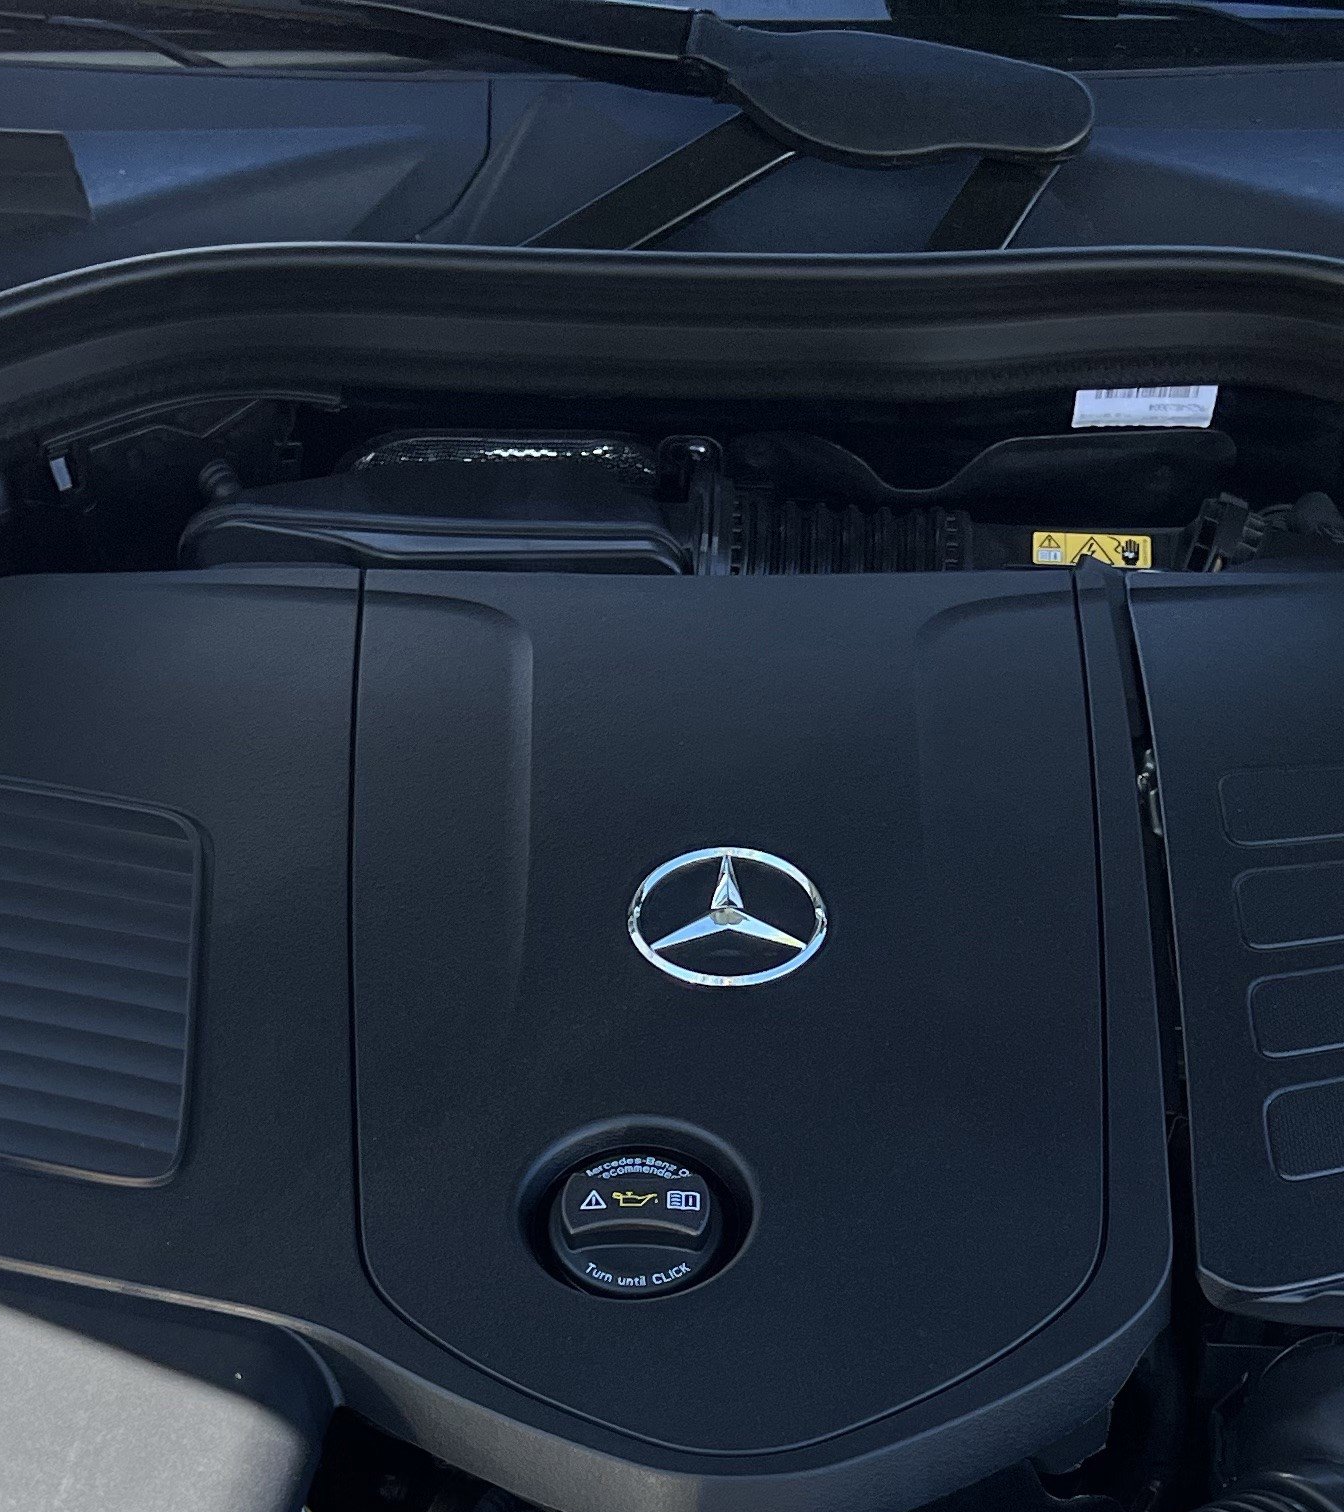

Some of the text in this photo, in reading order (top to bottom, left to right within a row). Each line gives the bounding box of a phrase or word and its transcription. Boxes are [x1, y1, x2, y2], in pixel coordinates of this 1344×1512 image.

[585, 1262, 692, 1287] Turn until CLICK
